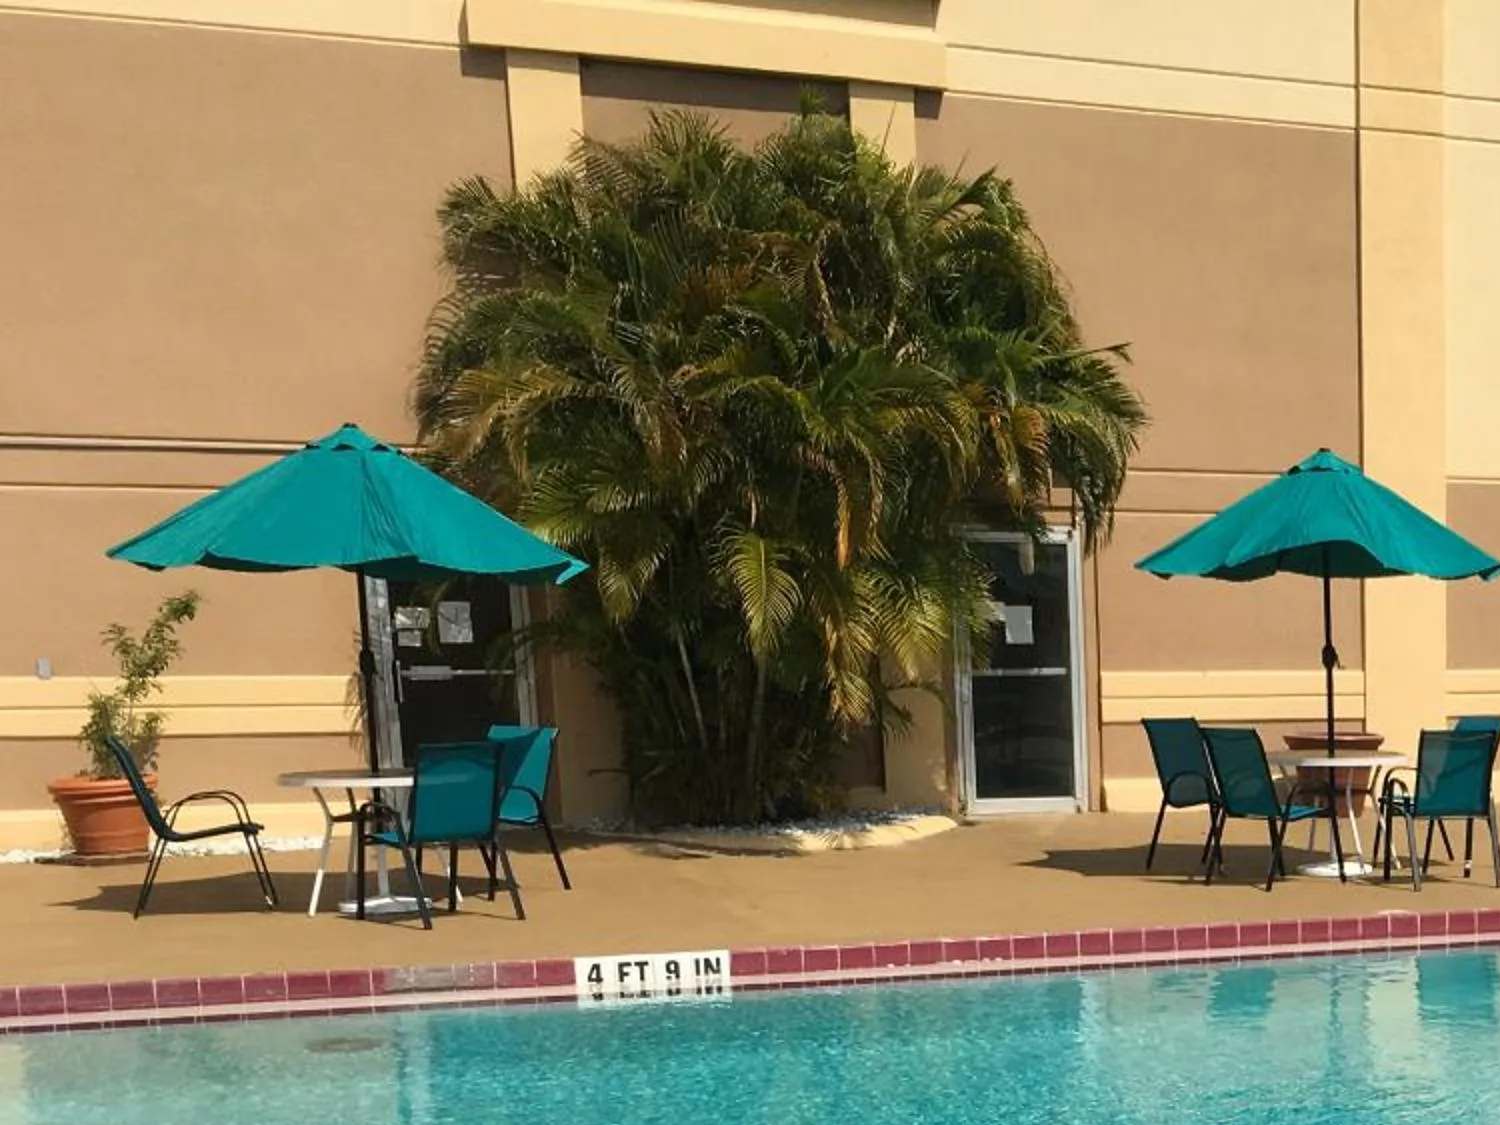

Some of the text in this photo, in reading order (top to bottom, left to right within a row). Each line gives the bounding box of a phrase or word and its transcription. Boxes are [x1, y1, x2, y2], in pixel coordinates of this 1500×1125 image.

[588, 957, 721, 984] 4 FT 9 IN
